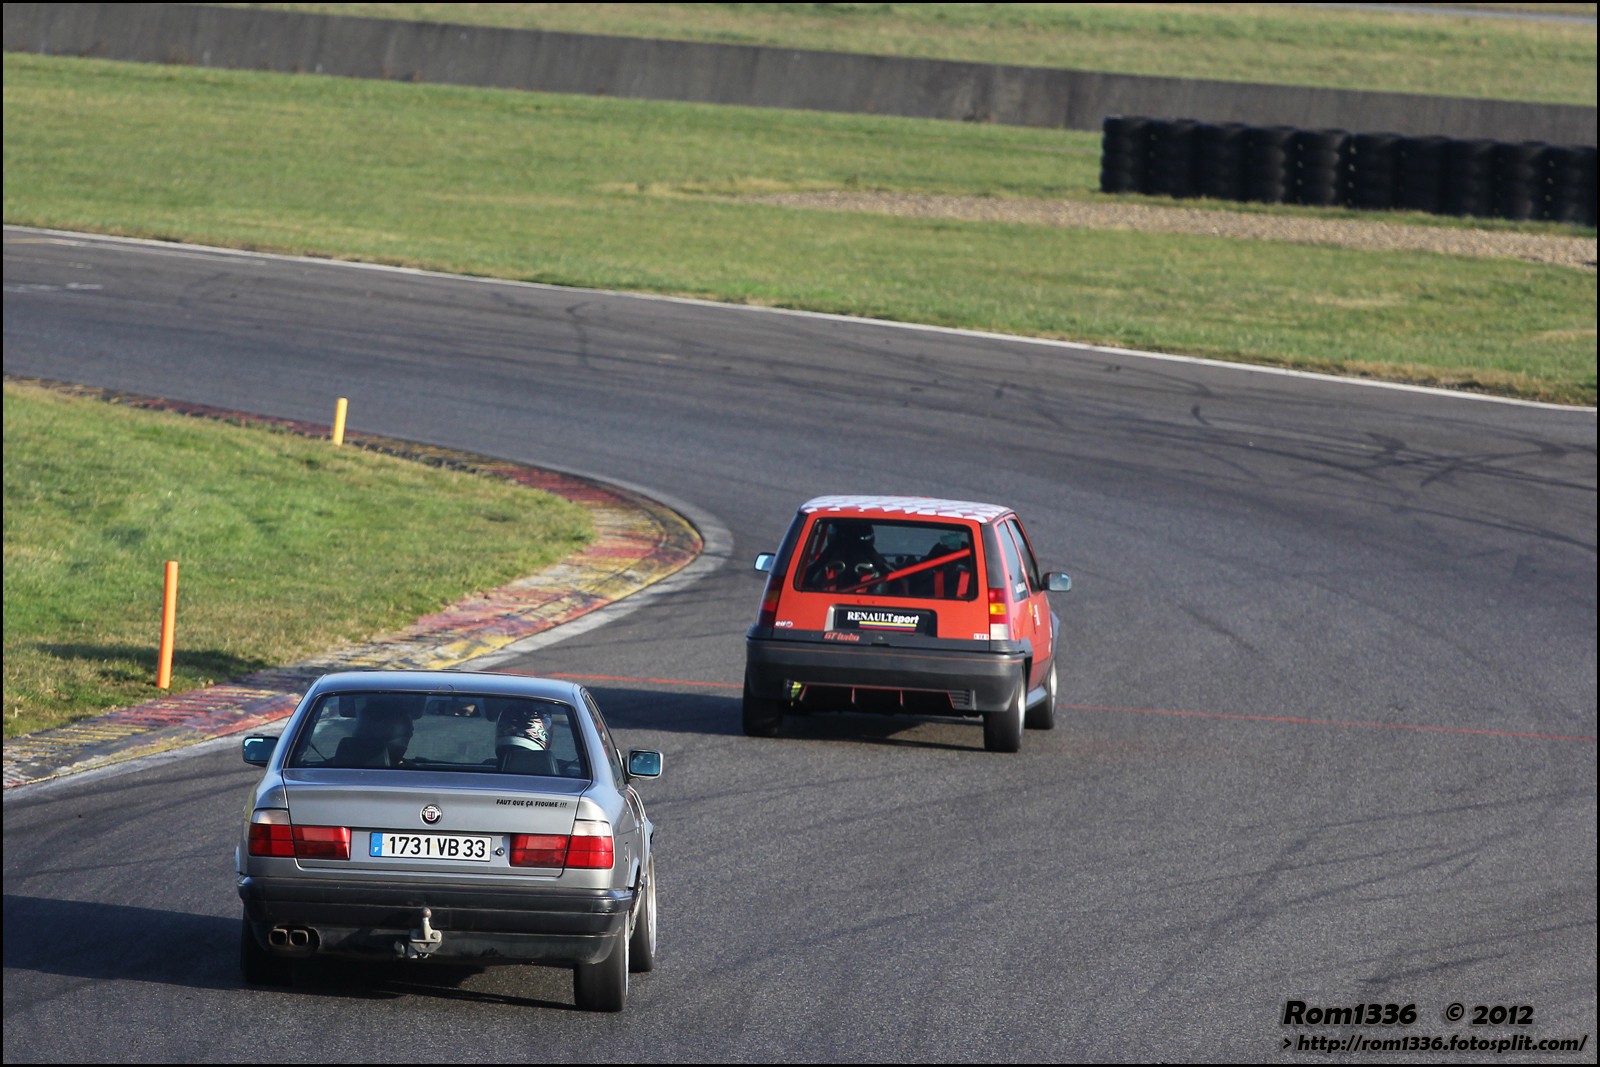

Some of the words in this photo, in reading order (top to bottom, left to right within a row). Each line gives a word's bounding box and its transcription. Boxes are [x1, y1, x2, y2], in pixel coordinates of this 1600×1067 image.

[847, 611, 920, 625] RENAULTsport
[824, 632, 837, 640] GT
[837, 633, 860, 641] turbo
[526, 800, 534, 808] ÇA
[389, 836, 431, 855] 1731
[437, 838, 460, 856] VB
[462, 839, 486, 858] 33
